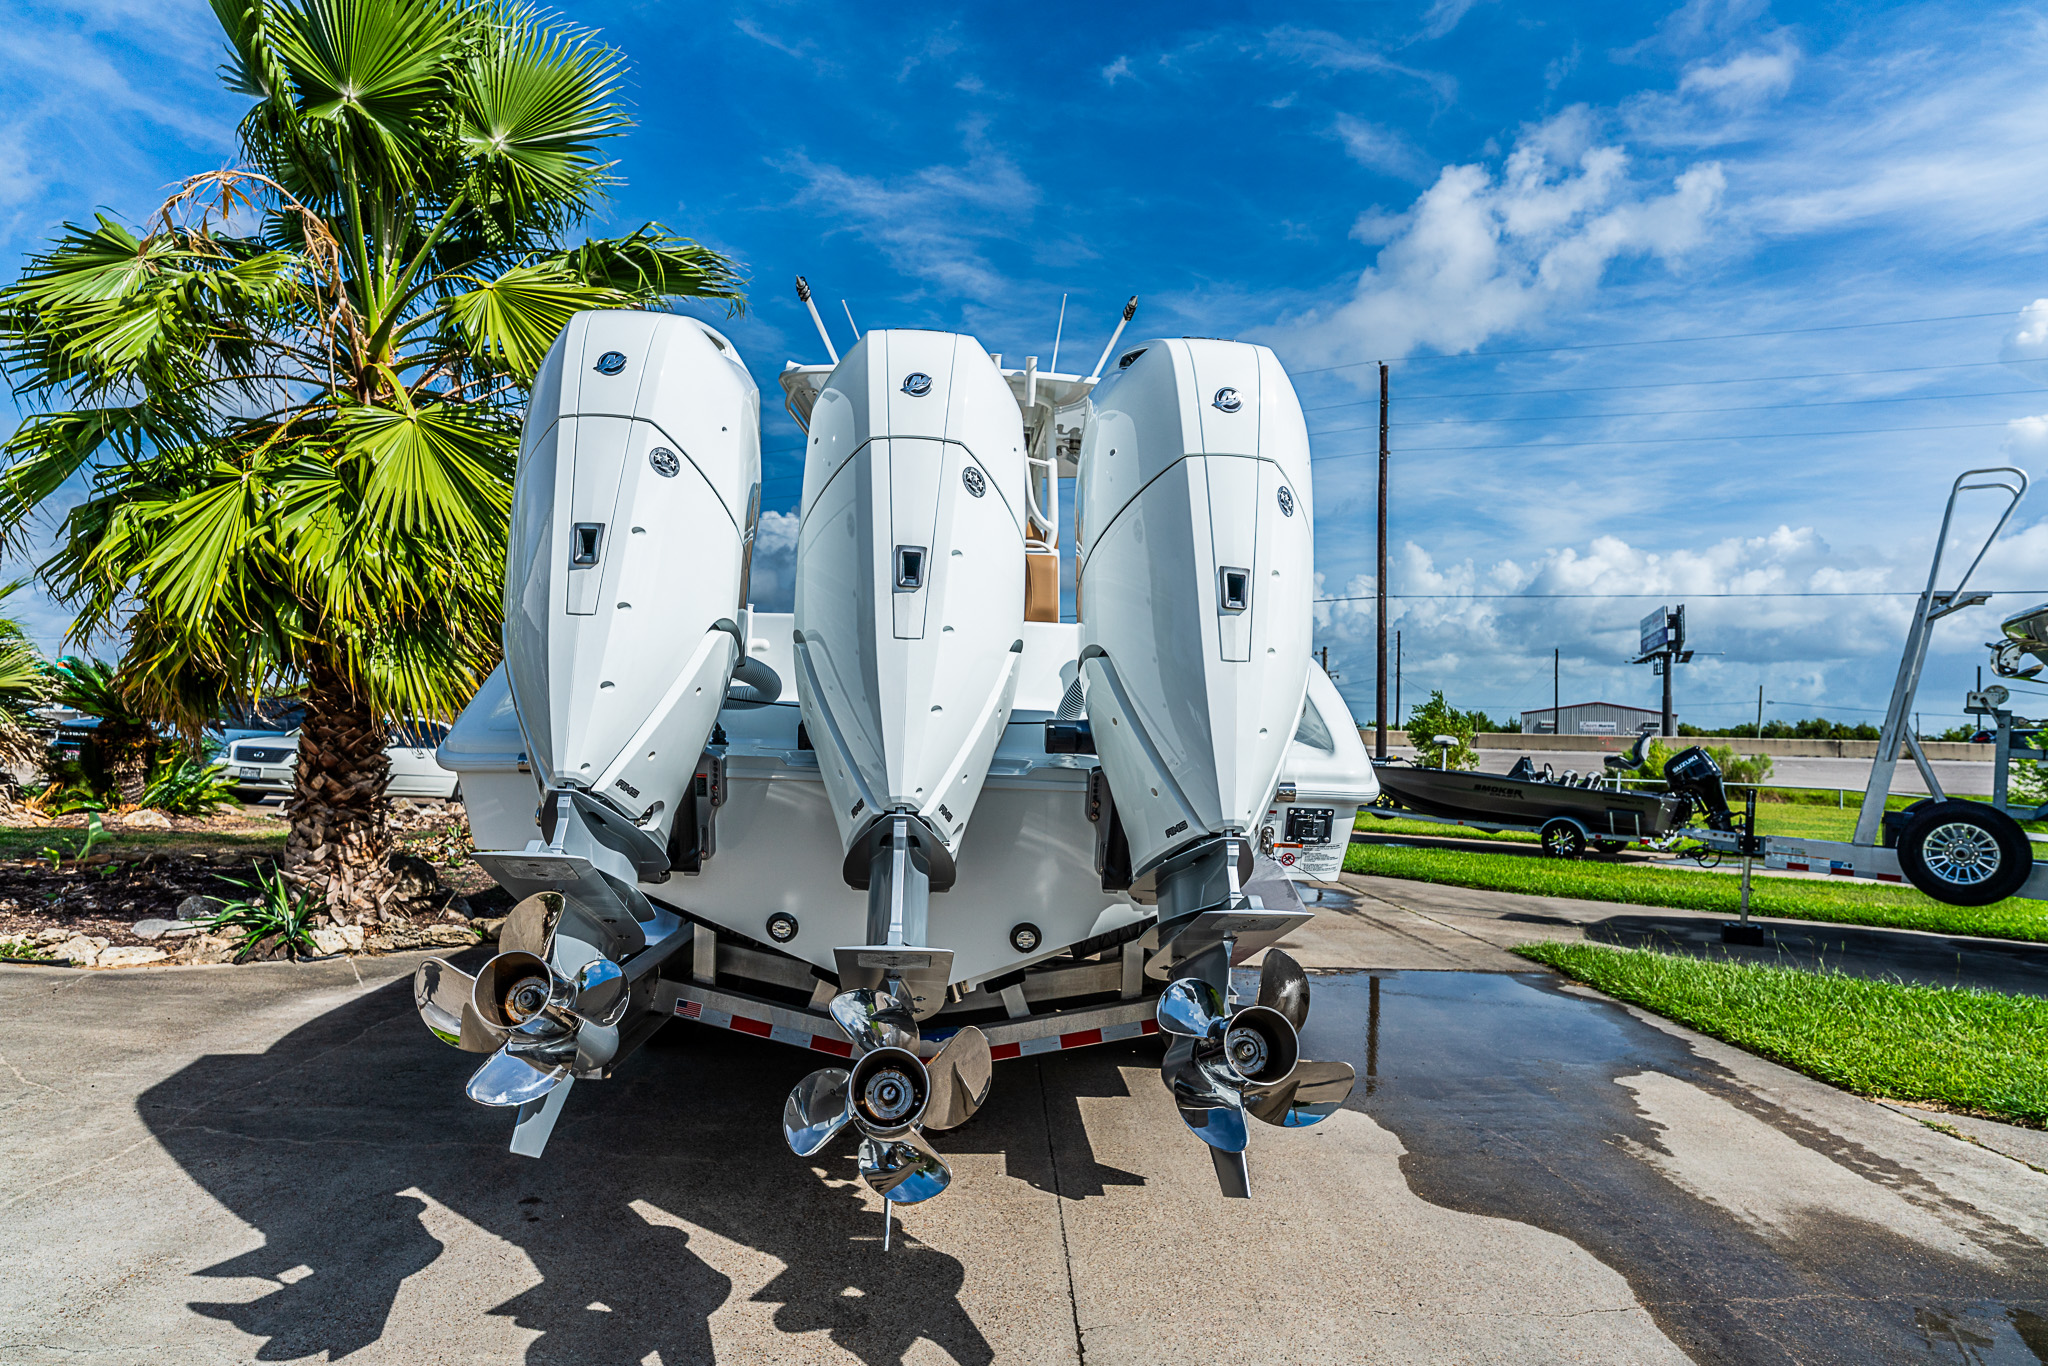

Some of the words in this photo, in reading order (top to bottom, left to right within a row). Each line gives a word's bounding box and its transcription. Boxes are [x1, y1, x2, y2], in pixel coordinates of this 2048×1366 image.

[1672, 754, 1699, 773] SUZUKI
[615, 778, 640, 798] AMS
[1474, 784, 1525, 800] SMOKER
[1165, 820, 1189, 838] AMS
